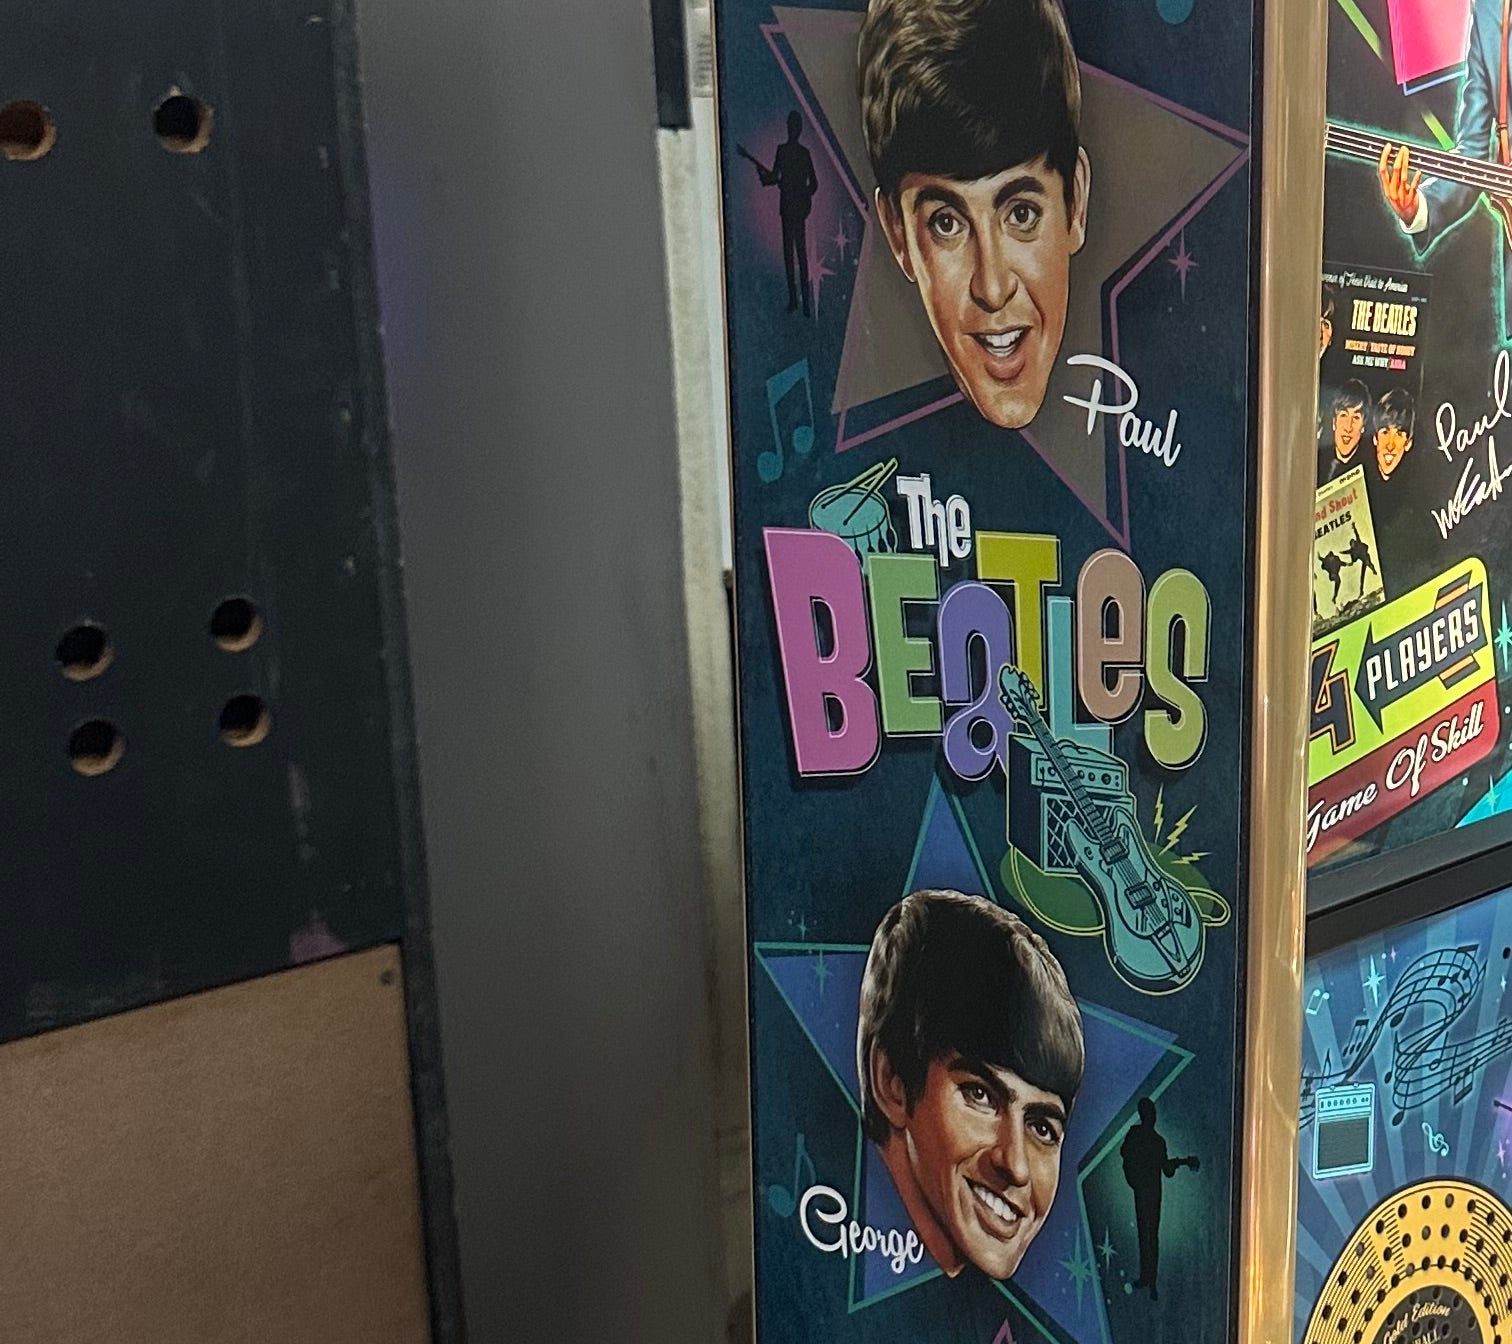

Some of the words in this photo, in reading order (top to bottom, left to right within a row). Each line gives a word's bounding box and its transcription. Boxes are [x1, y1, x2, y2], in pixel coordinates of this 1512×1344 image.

[1351, 299, 1373, 332] THE
[1372, 301, 1418, 337] BEATLES
[1063, 354, 1181, 467] Paul
[1436, 349, 1512, 461] Paul
[896, 473, 972, 567] The
[1329, 488, 1358, 513] Shout
[1365, 599, 1479, 701] PLAYERS
[1386, 723, 1426, 797] Of
[1431, 700, 1486, 763] Skill
[798, 1184, 925, 1275] George
[1411, 1302, 1450, 1323] Edition
